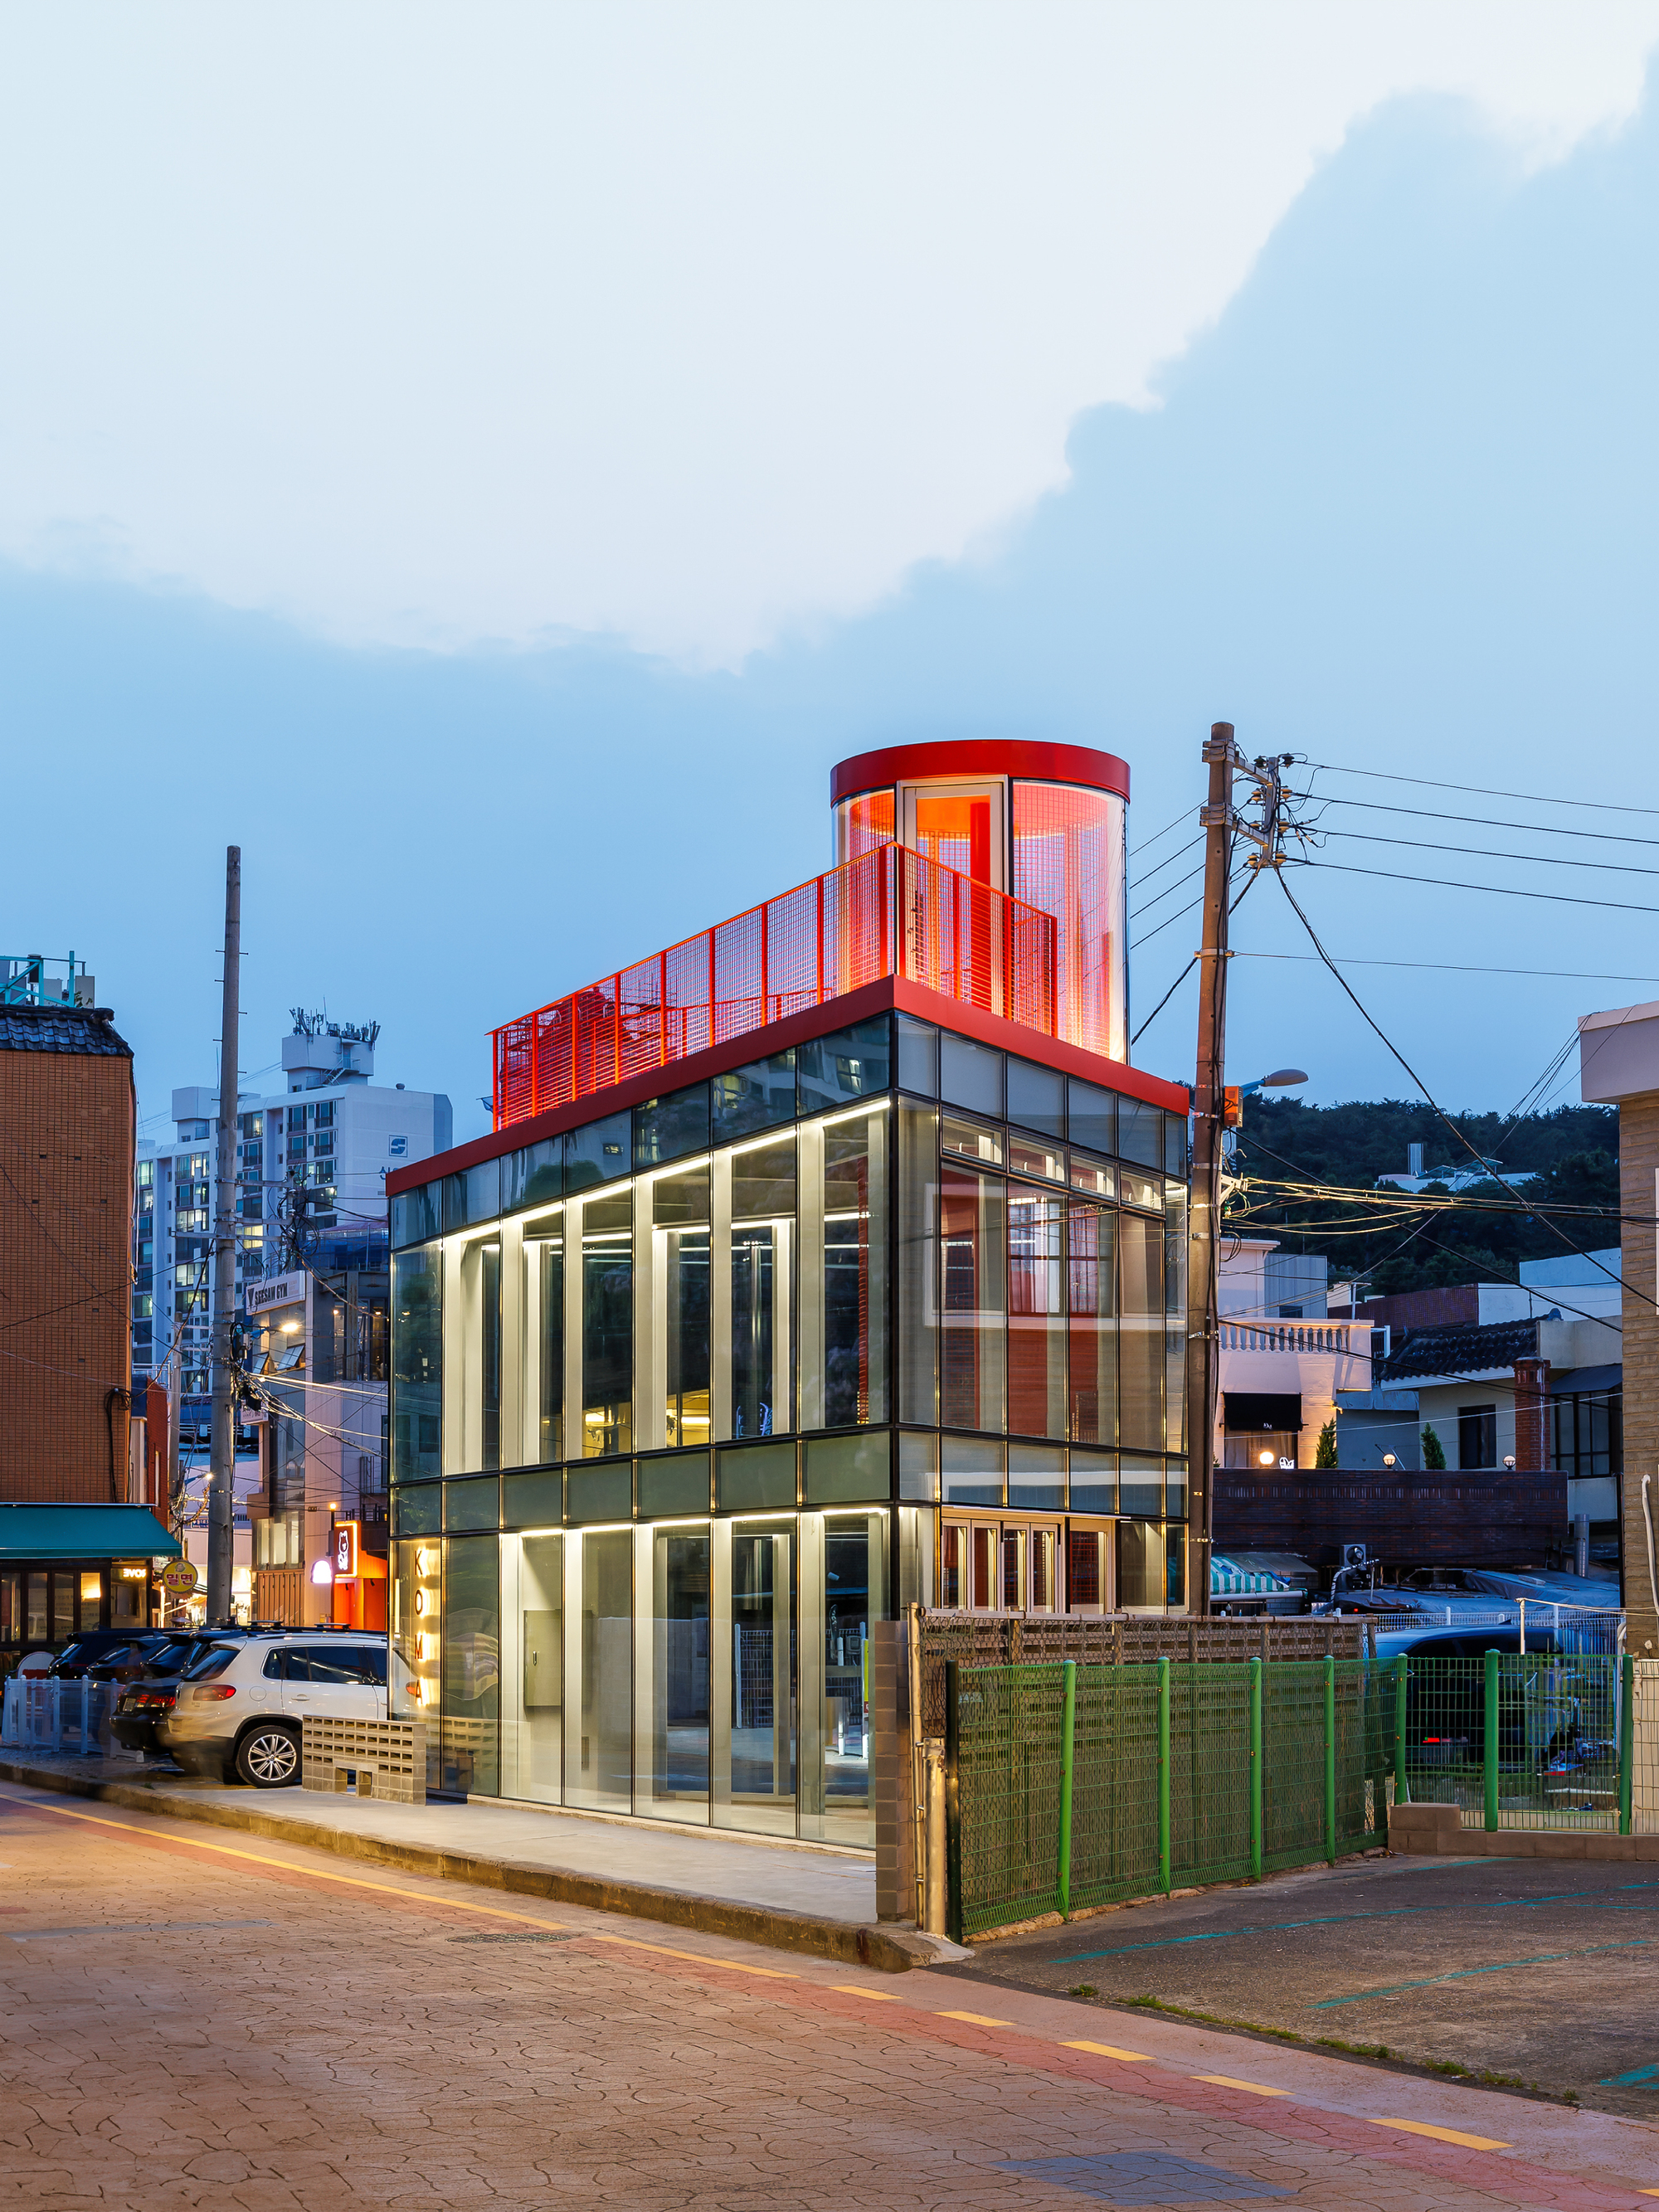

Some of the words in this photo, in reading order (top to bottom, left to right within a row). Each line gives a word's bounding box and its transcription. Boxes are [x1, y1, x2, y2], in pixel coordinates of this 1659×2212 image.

[276, 1282, 288, 1300] GYM
[166, 1573, 193, 1586] 밀면
[415, 1550, 423, 1704] KOMA
